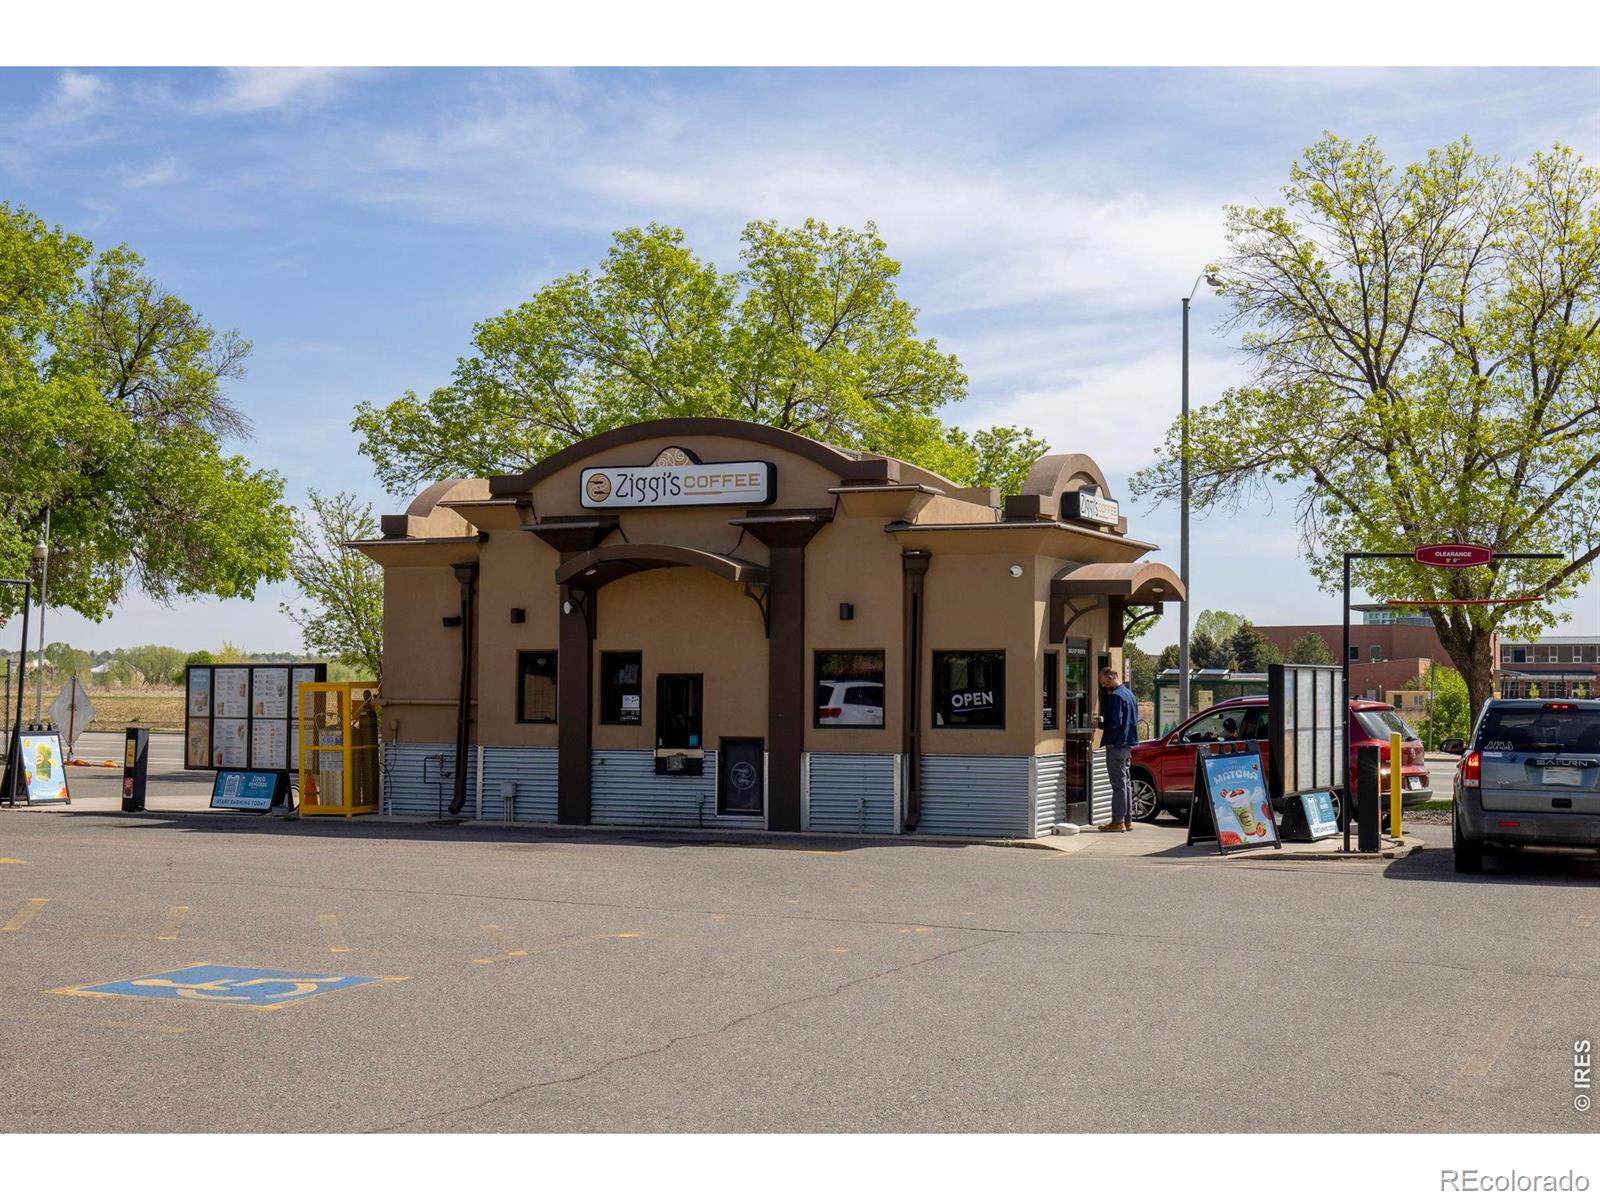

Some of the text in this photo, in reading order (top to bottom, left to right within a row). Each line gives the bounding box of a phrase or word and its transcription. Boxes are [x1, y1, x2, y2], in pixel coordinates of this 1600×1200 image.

[615, 472, 761, 503] Ziggi's COFFEE
[951, 691, 993, 707] OPEN
[1536, 759, 1588, 767] SATURN
[1213, 770, 1258, 785] MATCHA
